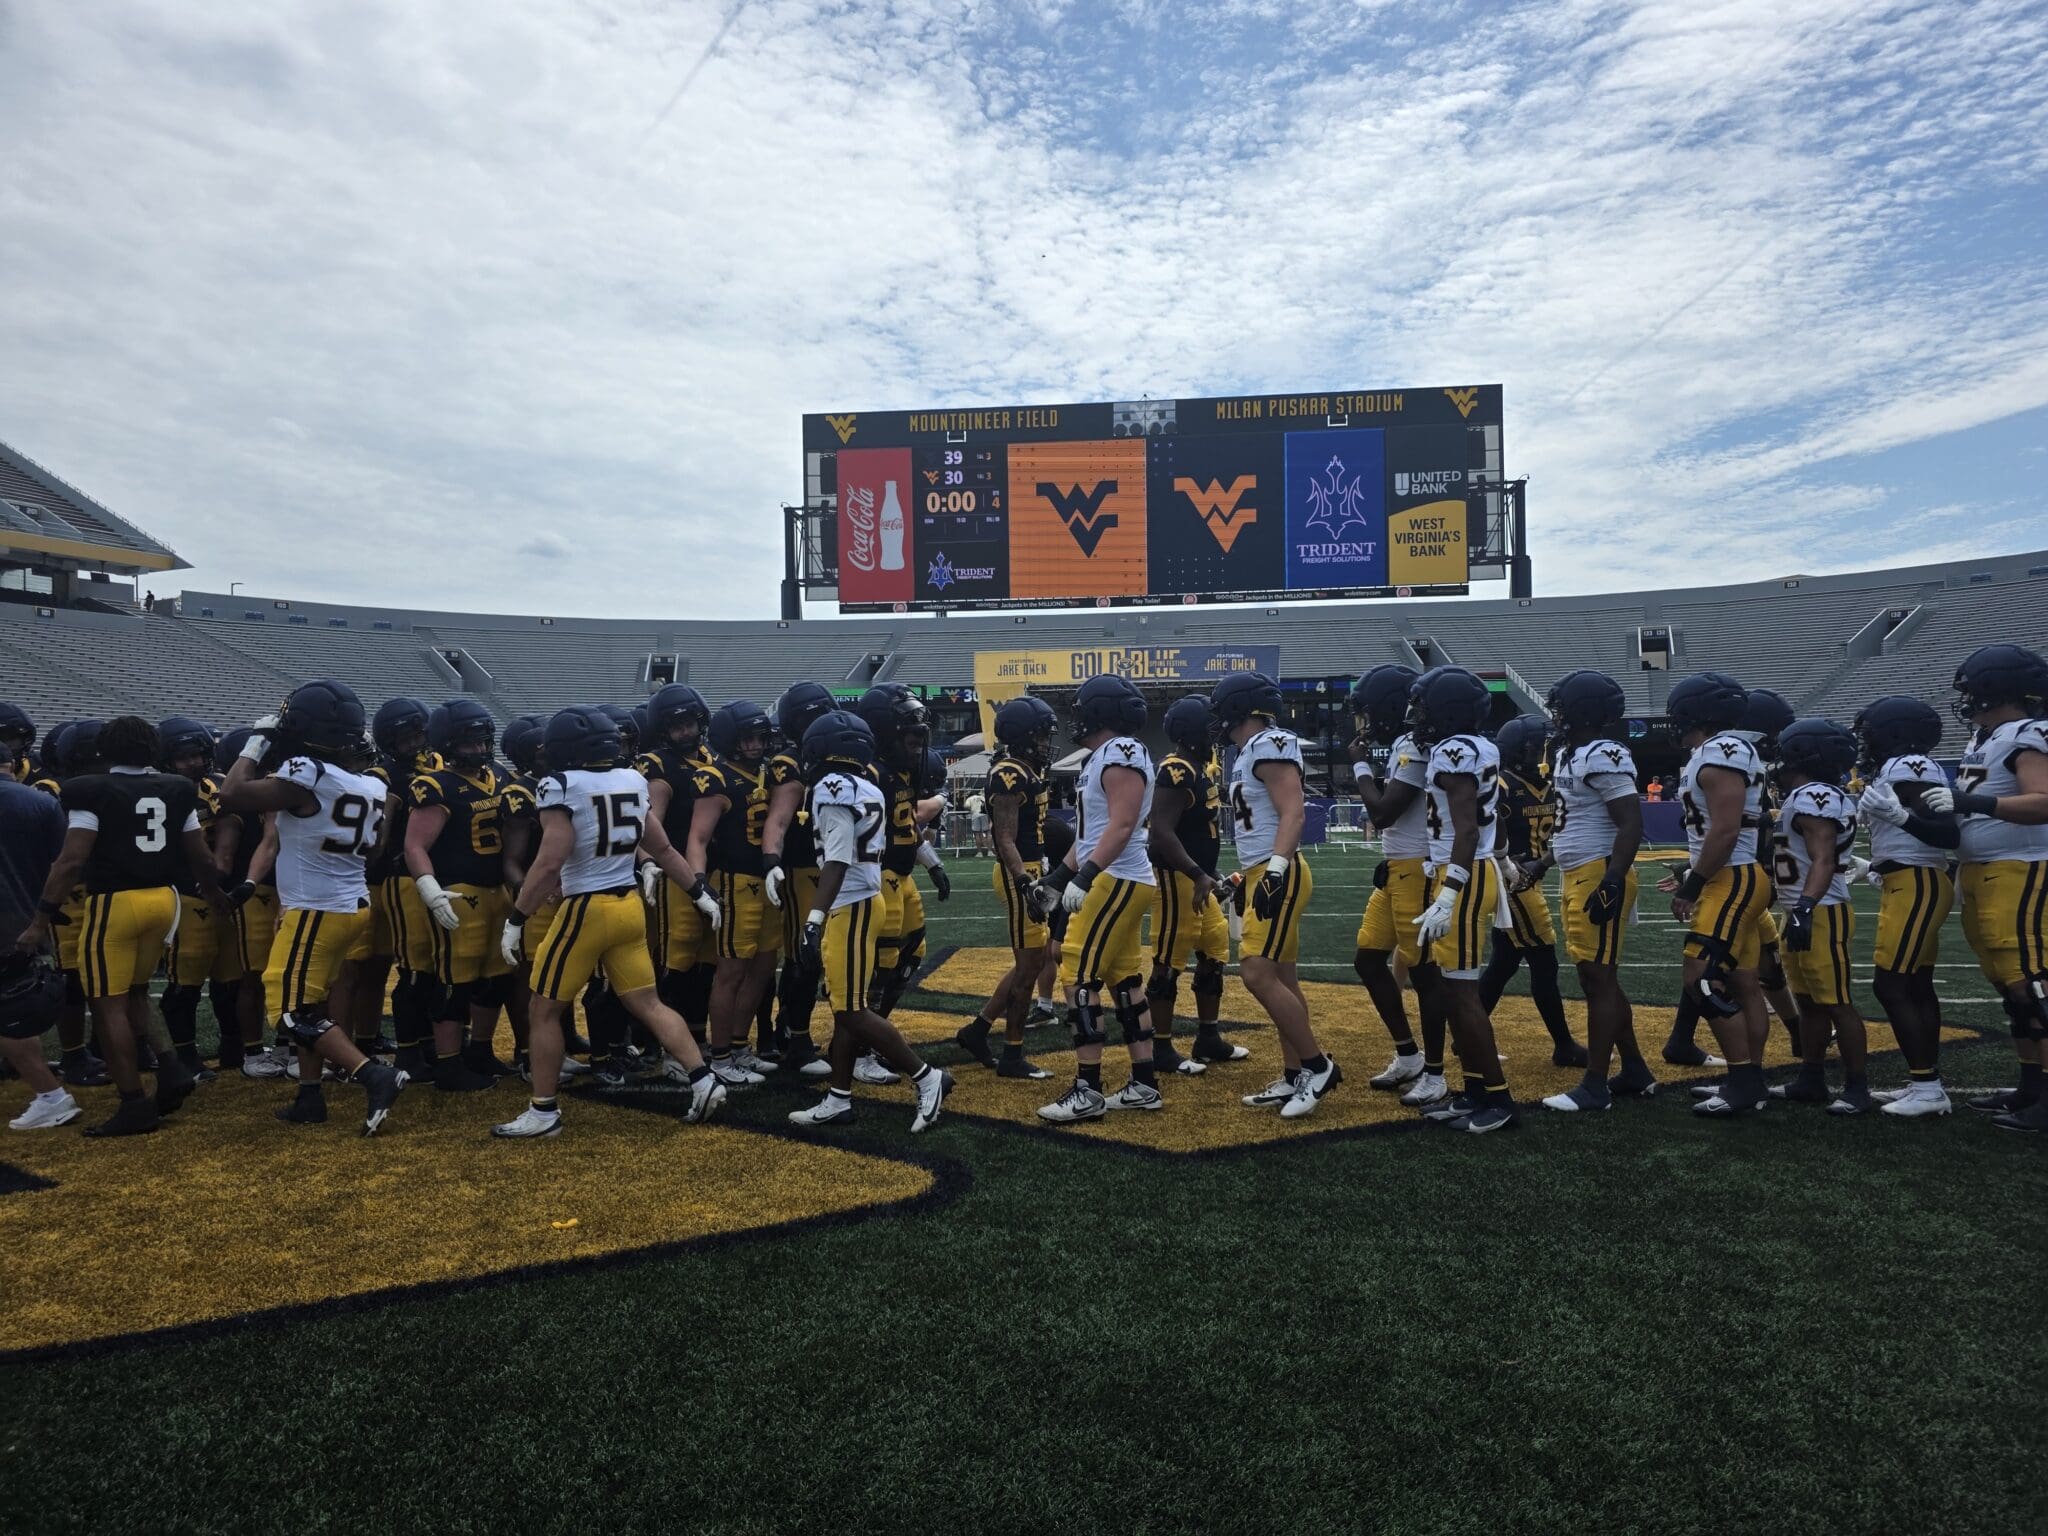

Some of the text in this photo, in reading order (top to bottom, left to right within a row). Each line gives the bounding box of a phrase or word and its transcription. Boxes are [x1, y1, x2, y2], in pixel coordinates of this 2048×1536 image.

[1216, 393, 1404, 420] MILAN PUSKAR STADIUM
[909, 409, 1059, 432] MOUNTAINEER FIELD
[944, 451, 963, 465] 39
[944, 471, 964, 485] 30
[1411, 471, 1462, 483] UNITED
[1411, 483, 1448, 495] BANK
[926, 491, 976, 513] 0:00
[991, 496, 1001, 509] 4
[1409, 517, 1446, 530] WEST
[1394, 530, 1461, 545] VIRGINIA'S
[1296, 541, 1377, 557] TRIDENT
[1410, 545, 1446, 558] BANK
[1302, 555, 1371, 565] FREIGHT SOLUTIONS
[953, 567, 996, 577] TRIDENT
[1132, 598, 1144, 606] Play
[1245, 594, 1267, 602] Jackpots
[1001, 602, 1022, 610] Jackpots
[997, 663, 1047, 677] JAKE OWEN
[1204, 658, 1256, 671] JAKE OWEN
[1315, 681, 1327, 694] 4
[135, 796, 167, 853] 3
[591, 792, 643, 857] 15
